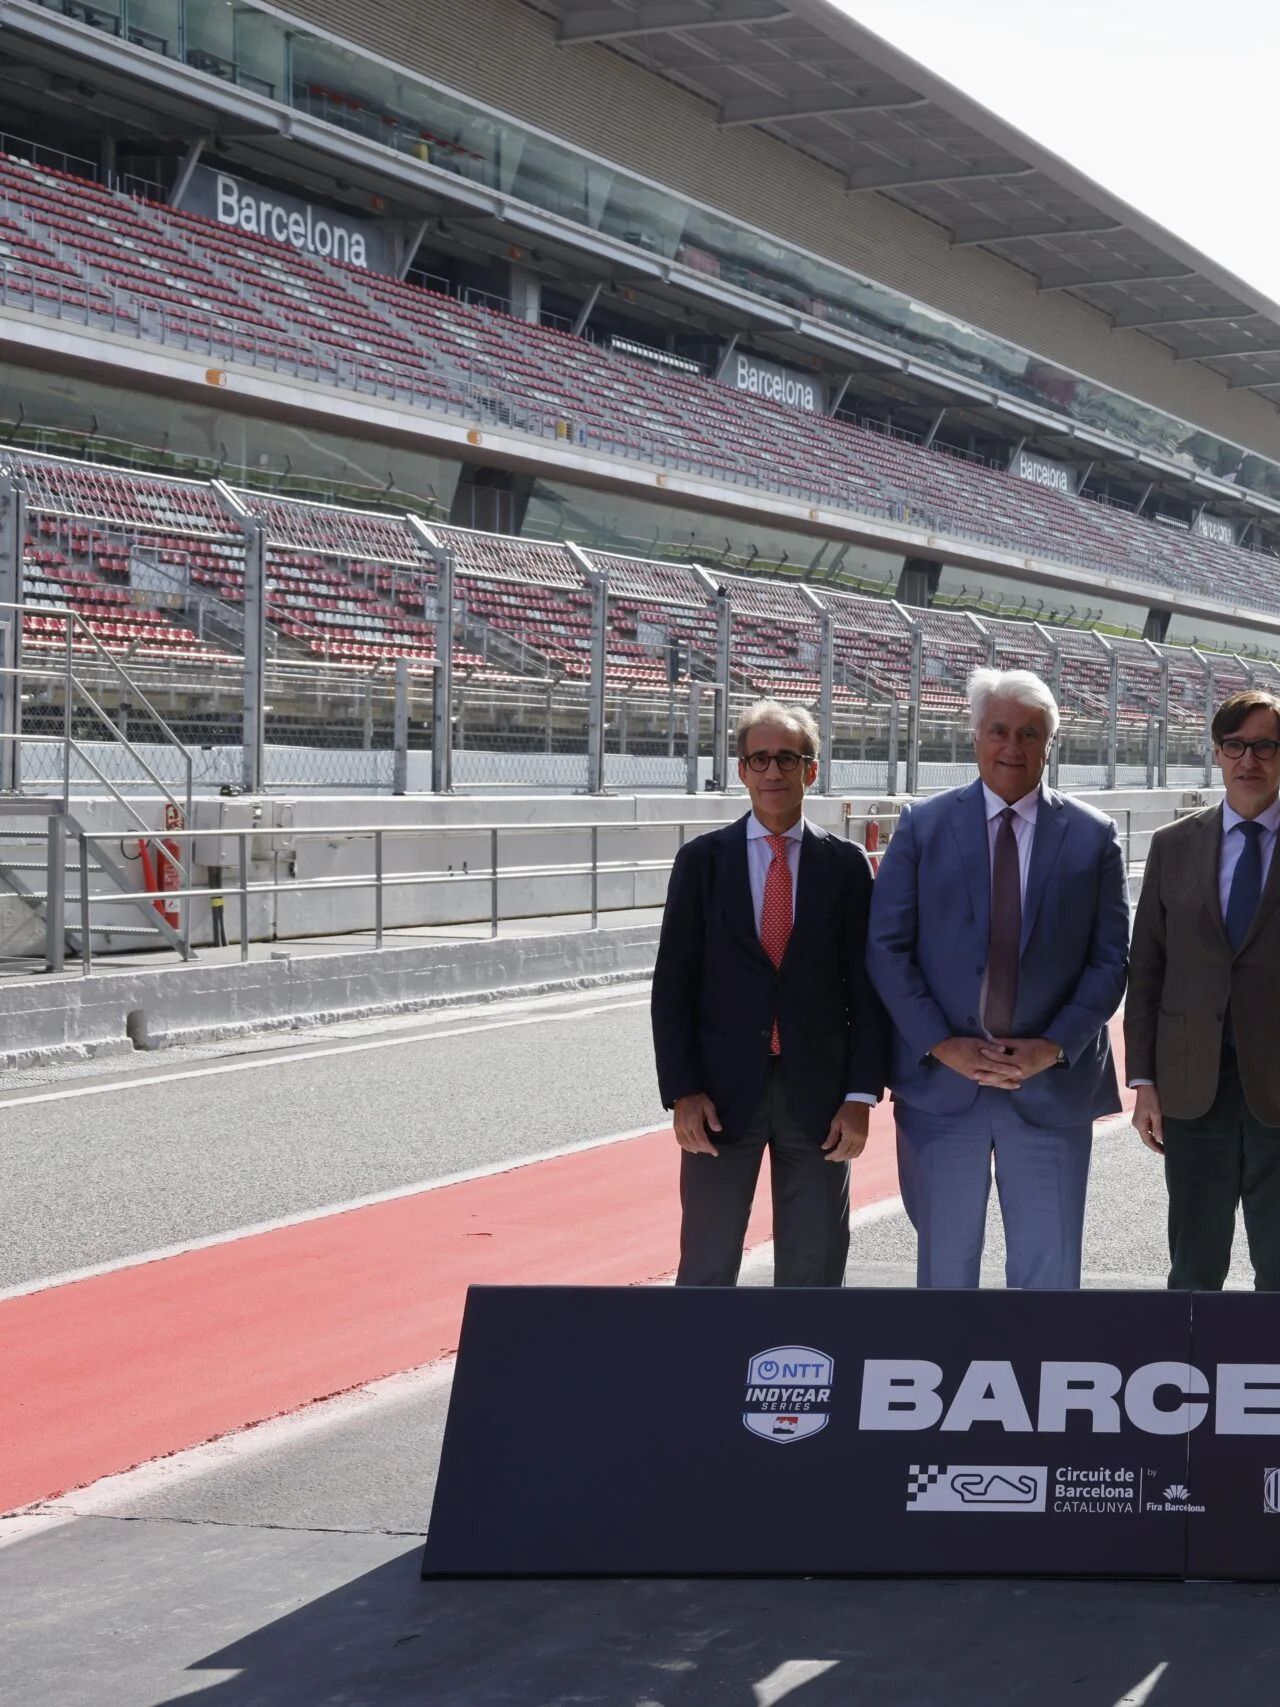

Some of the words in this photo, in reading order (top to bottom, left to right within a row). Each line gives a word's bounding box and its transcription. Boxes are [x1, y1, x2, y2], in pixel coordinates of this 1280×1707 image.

[217, 175, 367, 268] Barcelona
[737, 355, 814, 411] Barcelona
[1020, 456, 1068, 491] Barcelona
[782, 1363, 825, 1378] NTT
[745, 1388, 831, 1402] INDYCAR
[761, 1402, 811, 1411] SERIES
[1056, 1467, 1112, 1482] Circuit
[1114, 1467, 1135, 1482] de
[1147, 1468, 1158, 1478] by
[1055, 1484, 1134, 1498] Barcelona
[1054, 1501, 1133, 1513] CATALUNYA
[1146, 1502, 1163, 1511] Fira
[1165, 1502, 1206, 1512] Barcelona
